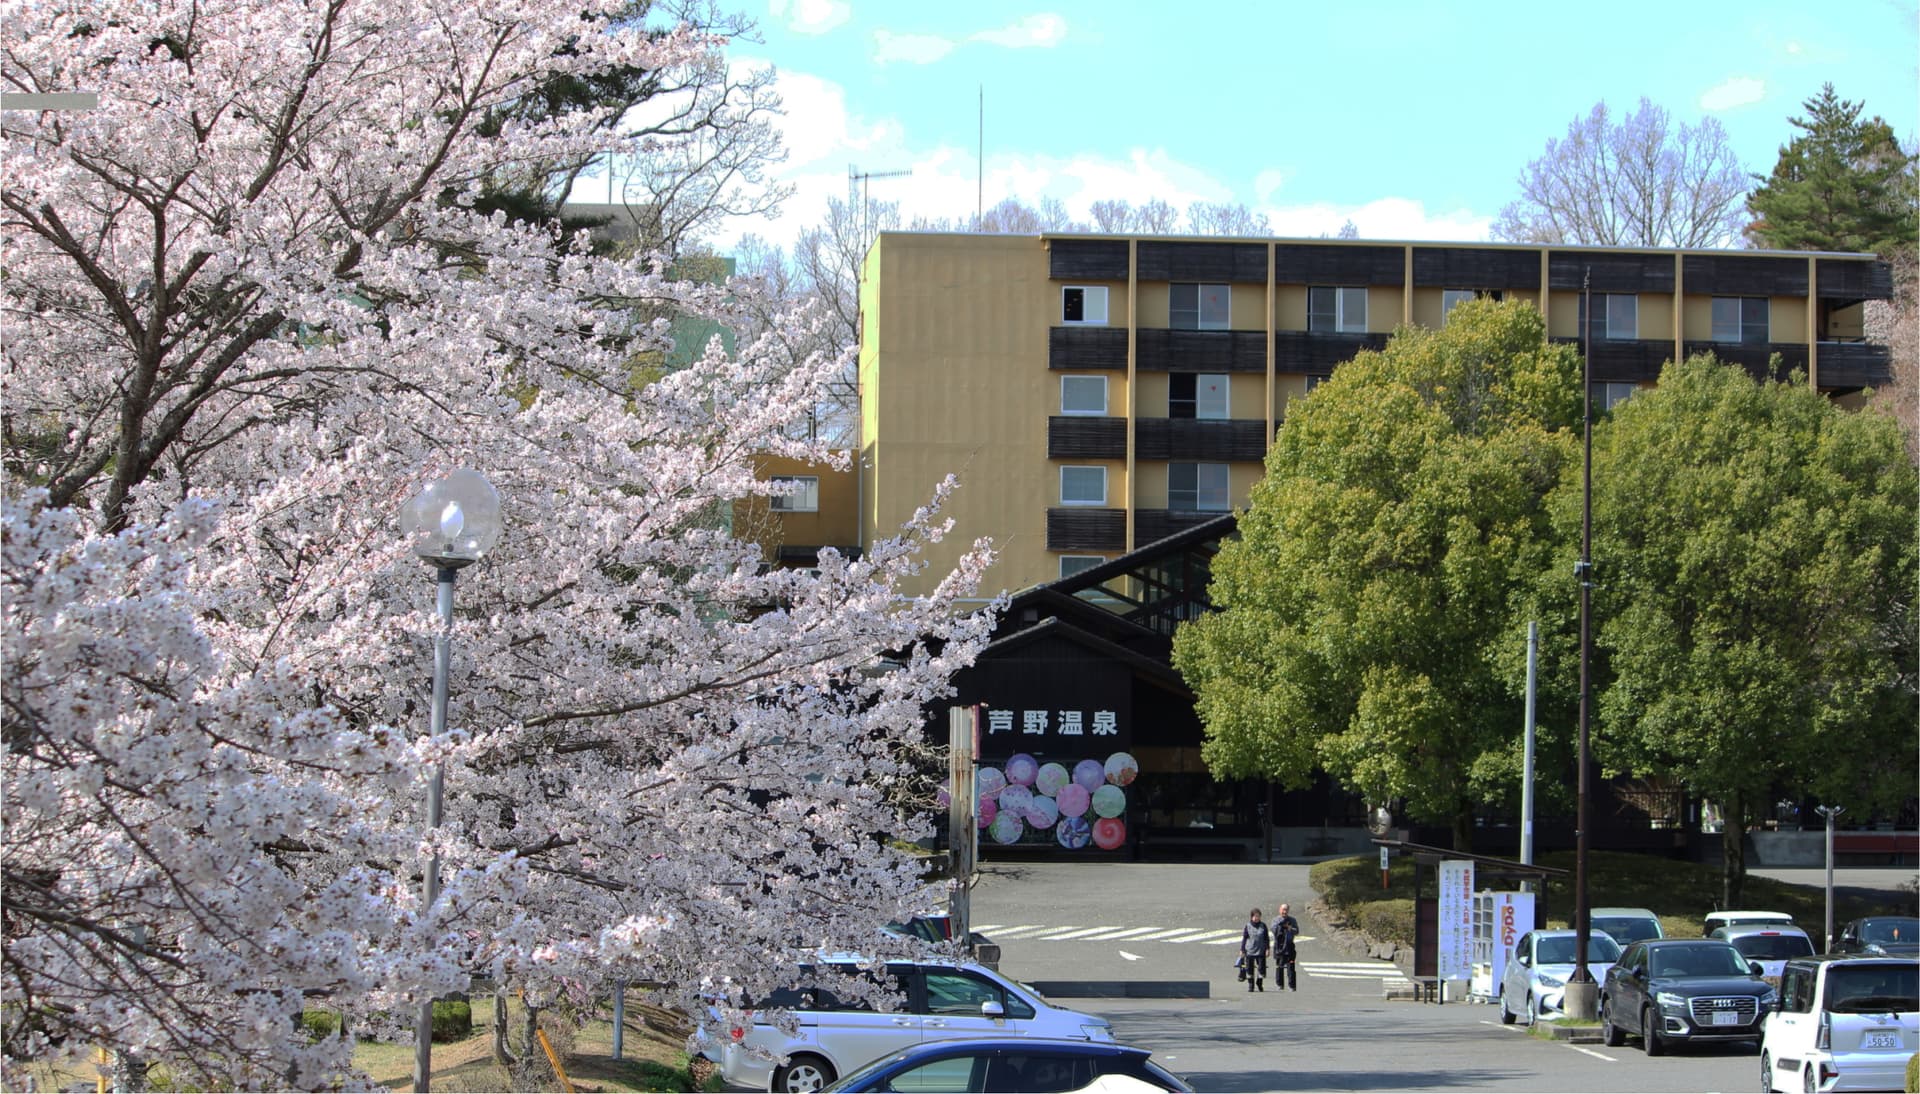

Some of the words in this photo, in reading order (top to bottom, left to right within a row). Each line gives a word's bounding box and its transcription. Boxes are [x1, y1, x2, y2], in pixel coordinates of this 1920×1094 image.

[988, 710, 1118, 735] 芦野温泉
[1504, 905, 1516, 945] DyDo
[1872, 1037, 1895, 1046] 50-50
